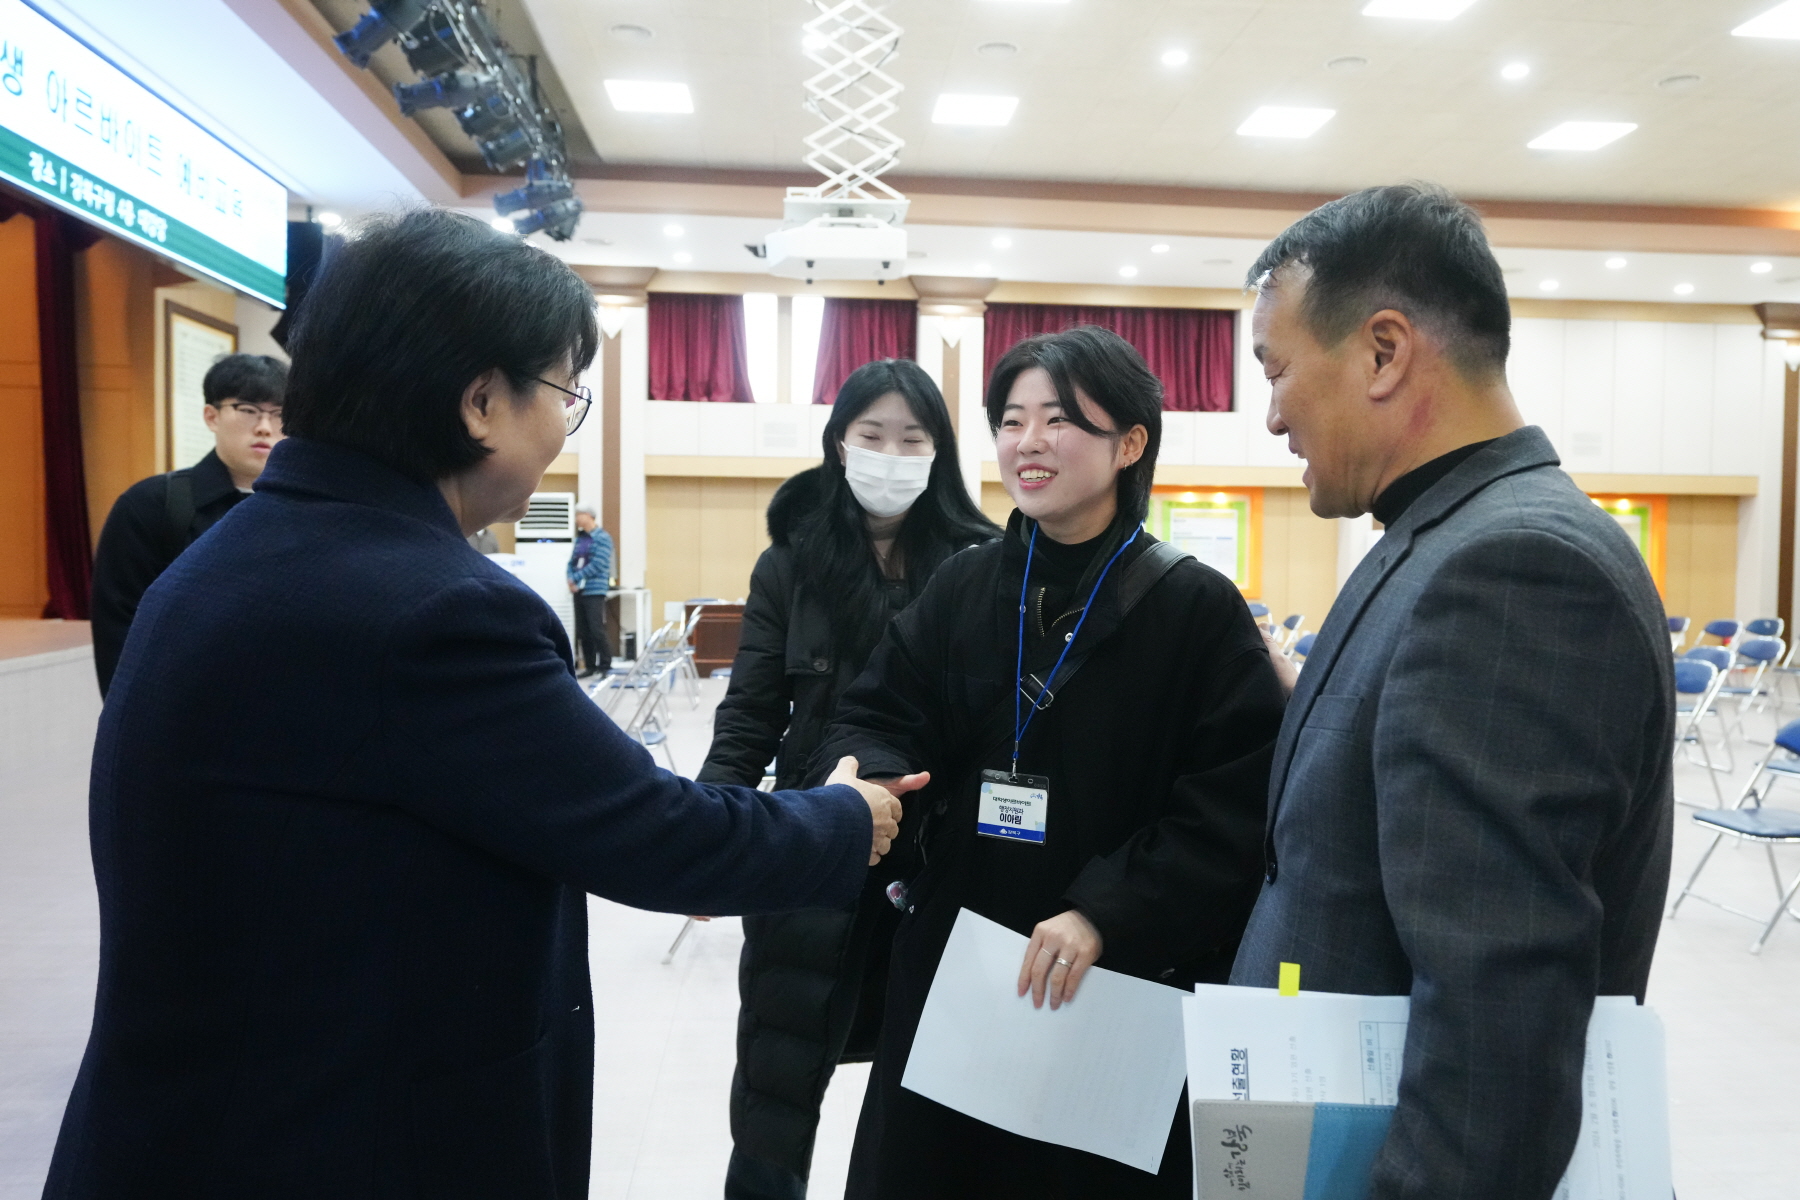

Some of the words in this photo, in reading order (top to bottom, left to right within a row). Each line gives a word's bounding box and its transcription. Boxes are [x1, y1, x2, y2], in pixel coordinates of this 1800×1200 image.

[46, 69, 163, 177] 아르바이트
[28, 150, 58, 186] 장소
[999, 813, 1022, 825] 이아림
